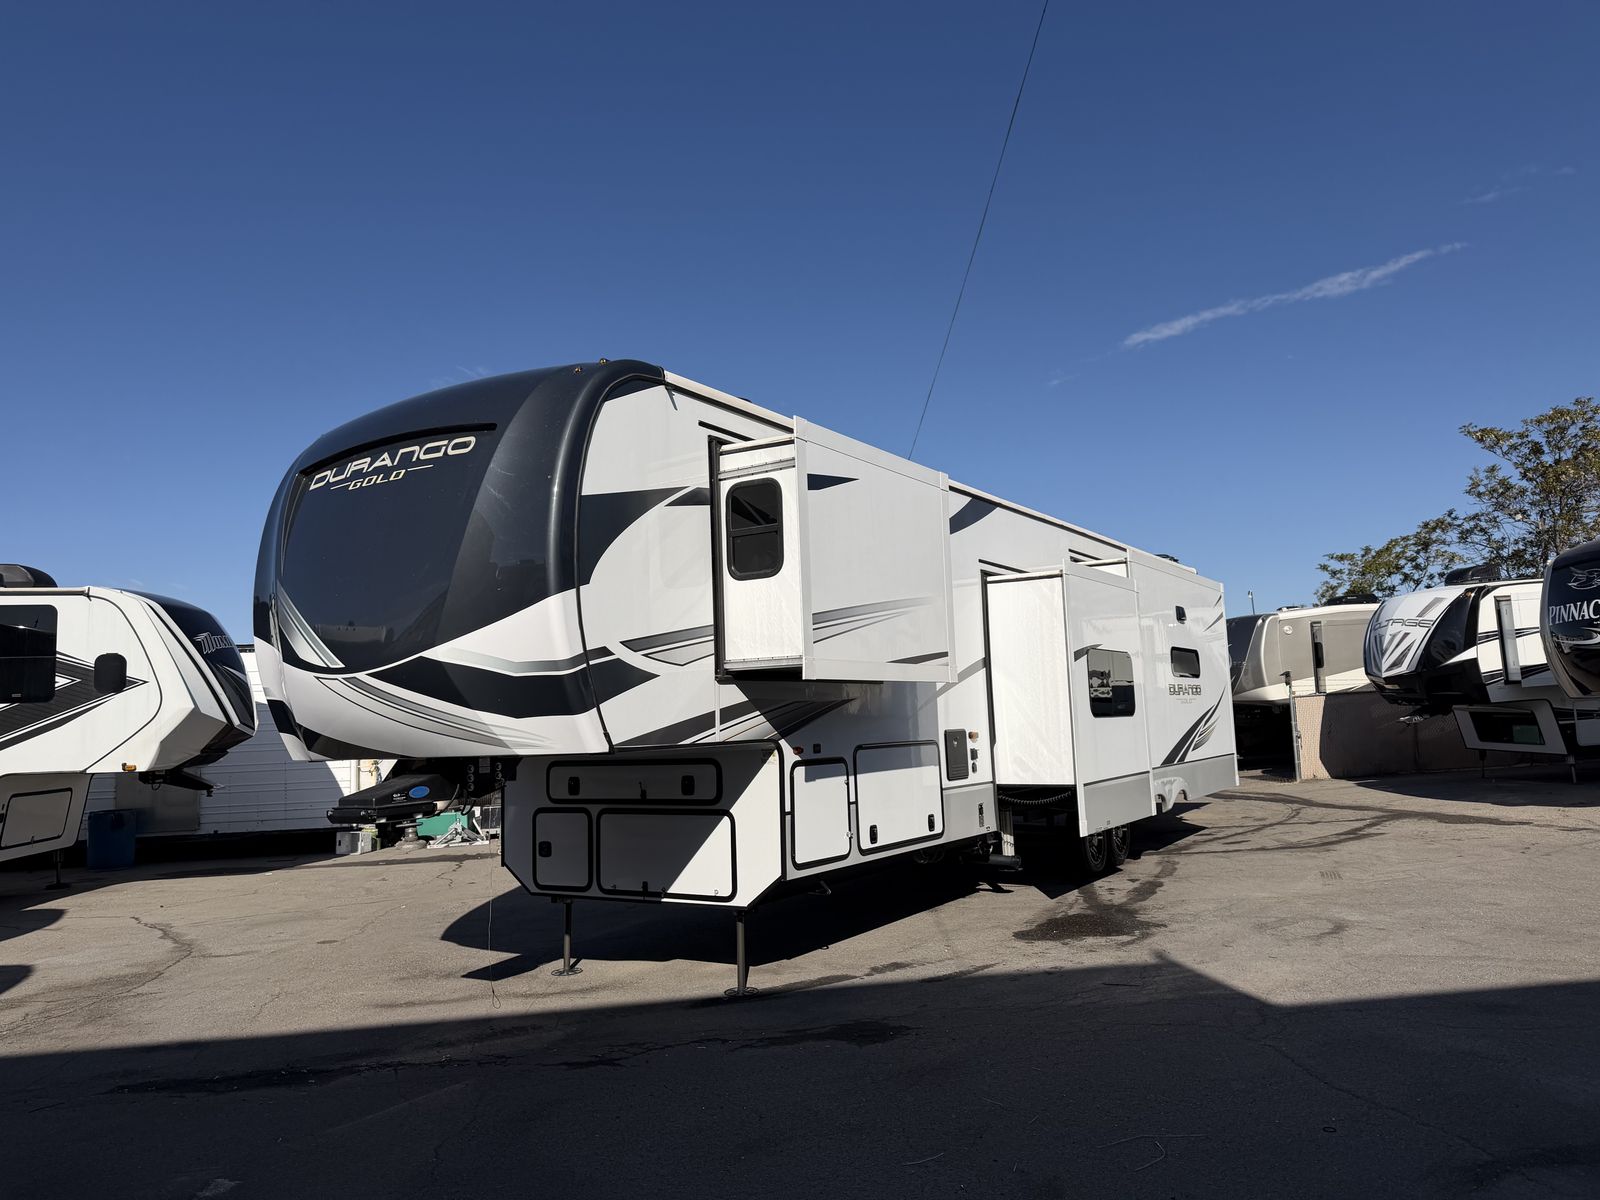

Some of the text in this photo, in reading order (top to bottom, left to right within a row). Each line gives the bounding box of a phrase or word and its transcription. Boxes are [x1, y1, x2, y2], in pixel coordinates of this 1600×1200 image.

[309, 436, 476, 491] DURANGO
[348, 469, 406, 490] GOLD
[1168, 684, 1201, 696] DURANGO
